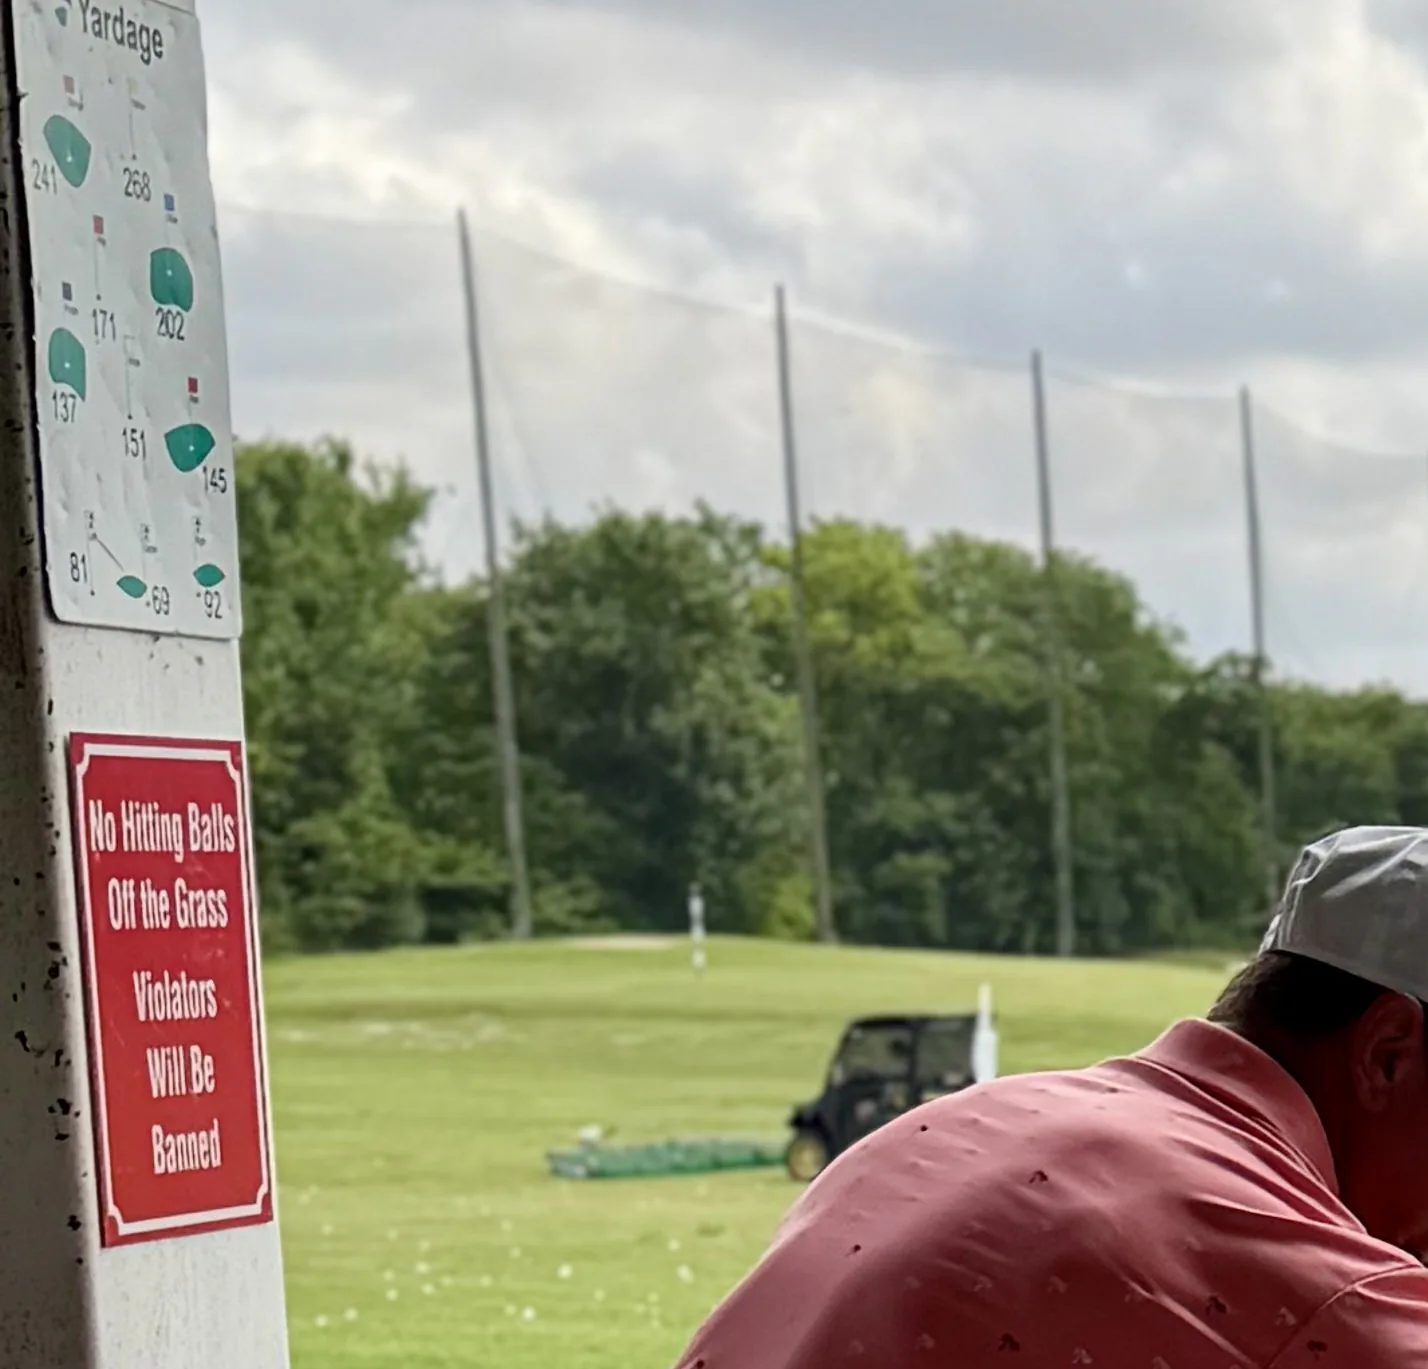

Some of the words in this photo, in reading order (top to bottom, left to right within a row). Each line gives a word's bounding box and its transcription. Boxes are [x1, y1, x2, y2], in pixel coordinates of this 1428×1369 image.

[79, 0, 165, 65] Yardage
[31, 158, 58, 195] 241
[122, 167, 151, 203] 268
[91, 308, 117, 341] 171
[155, 307, 186, 341] 202
[52, 393, 78, 423] 137
[122, 427, 148, 460] 151
[202, 466, 228, 494] 145
[69, 552, 88, 583] 81
[203, 590, 223, 619] 92
[89, 799, 116, 853] No
[121, 800, 184, 864] Hitting
[187, 802, 236, 854] Balls
[107, 878, 137, 931] Off
[141, 877, 171, 930] the
[174, 878, 229, 930] Grass
[132, 970, 218, 1022] Violators
[146, 1047, 186, 1099] Will
[189, 1045, 216, 1095] Be
[151, 1118, 222, 1175] Banned
